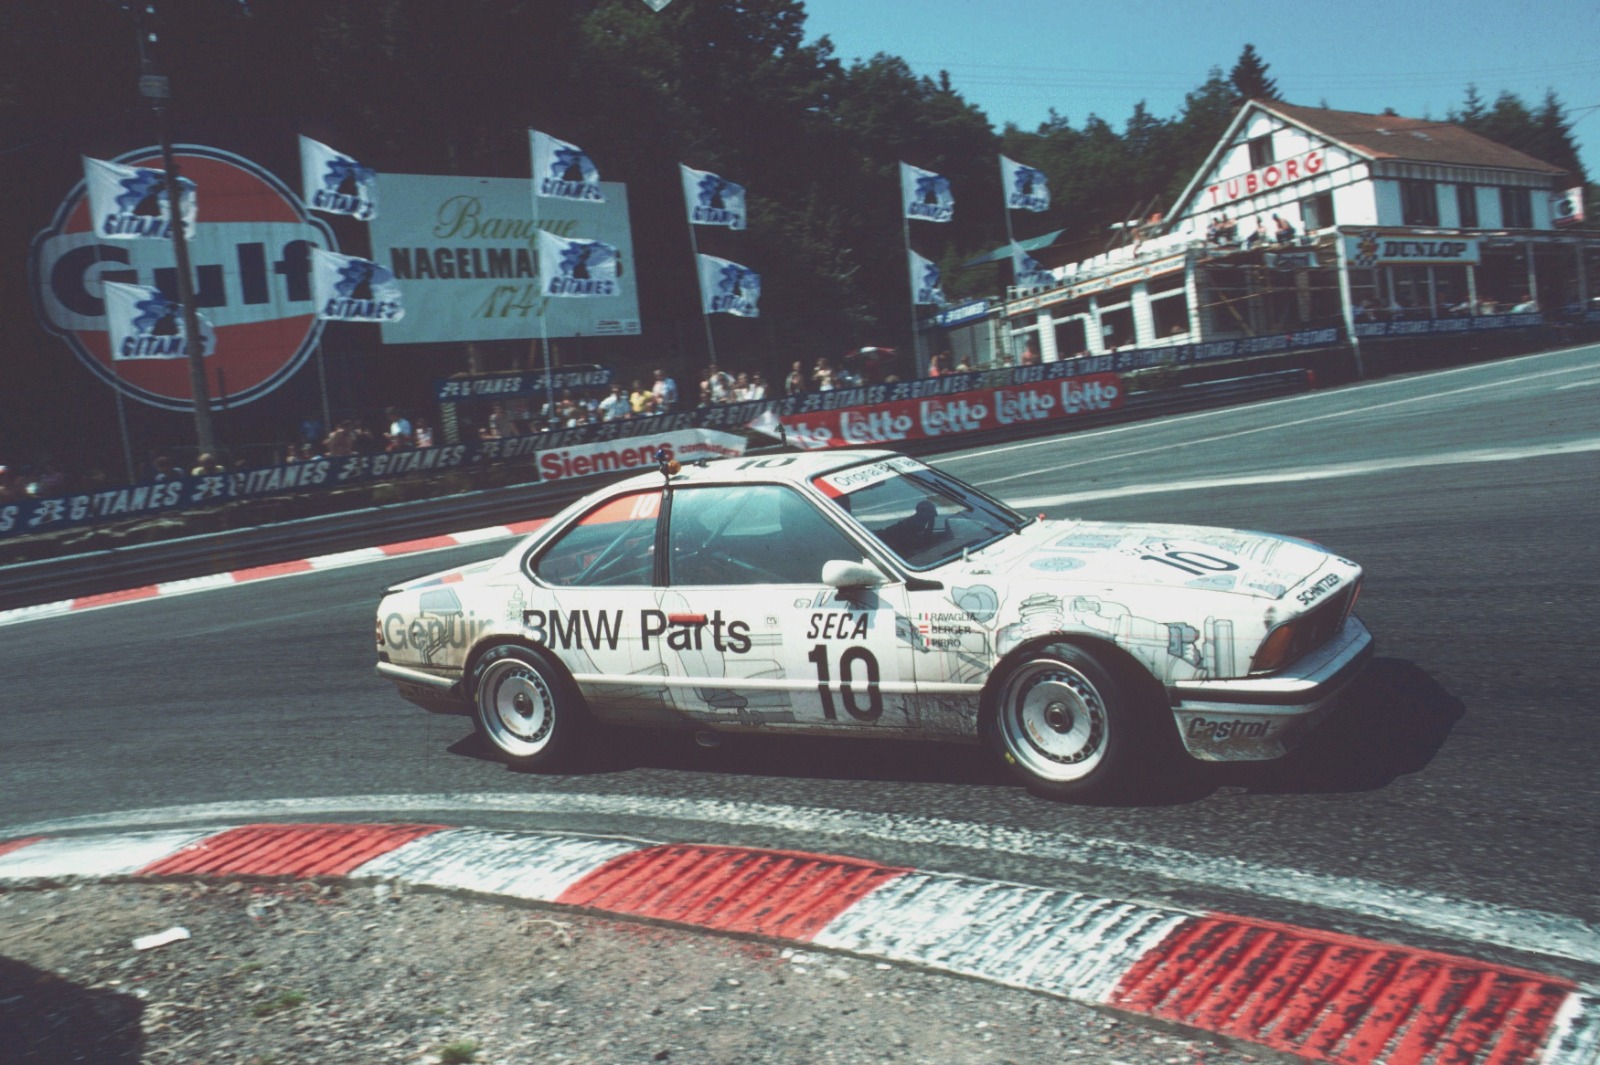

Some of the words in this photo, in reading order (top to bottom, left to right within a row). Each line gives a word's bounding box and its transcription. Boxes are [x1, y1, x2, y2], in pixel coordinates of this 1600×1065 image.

[1208, 151, 1323, 204] TUBORG
[433, 195, 579, 241] Banque
[391, 247, 624, 280] NAGELMA
[1382, 240, 1468, 258] DUNLOP
[51, 239, 319, 317] Gulf
[548, 276, 614, 295] GITANES
[919, 399, 988, 435] Lotto
[993, 390, 1055, 425] Lotto
[1061, 380, 1119, 414] Lotto
[228, 460, 330, 496] GITANES
[371, 445, 466, 476] GITANES
[502, 428, 586, 458] GITANES
[823, 385, 887, 410] GITANES
[911, 375, 970, 398] GITANES
[540, 441, 676, 480] Siemens
[735, 457, 797, 471] 10
[1140, 551, 1240, 576] 10
[1296, 573, 1340, 606] SCHNITZER
[384, 610, 496, 650] Genuin
[522, 610, 624, 651] BMW
[641, 609, 752, 654] Parts
[807, 613, 869, 640] SECA
[930, 612, 976, 622] RAVAGLIA
[931, 625, 971, 634] BERGER
[808, 644, 883, 722] 10
[1187, 717, 1271, 739] Castrol
